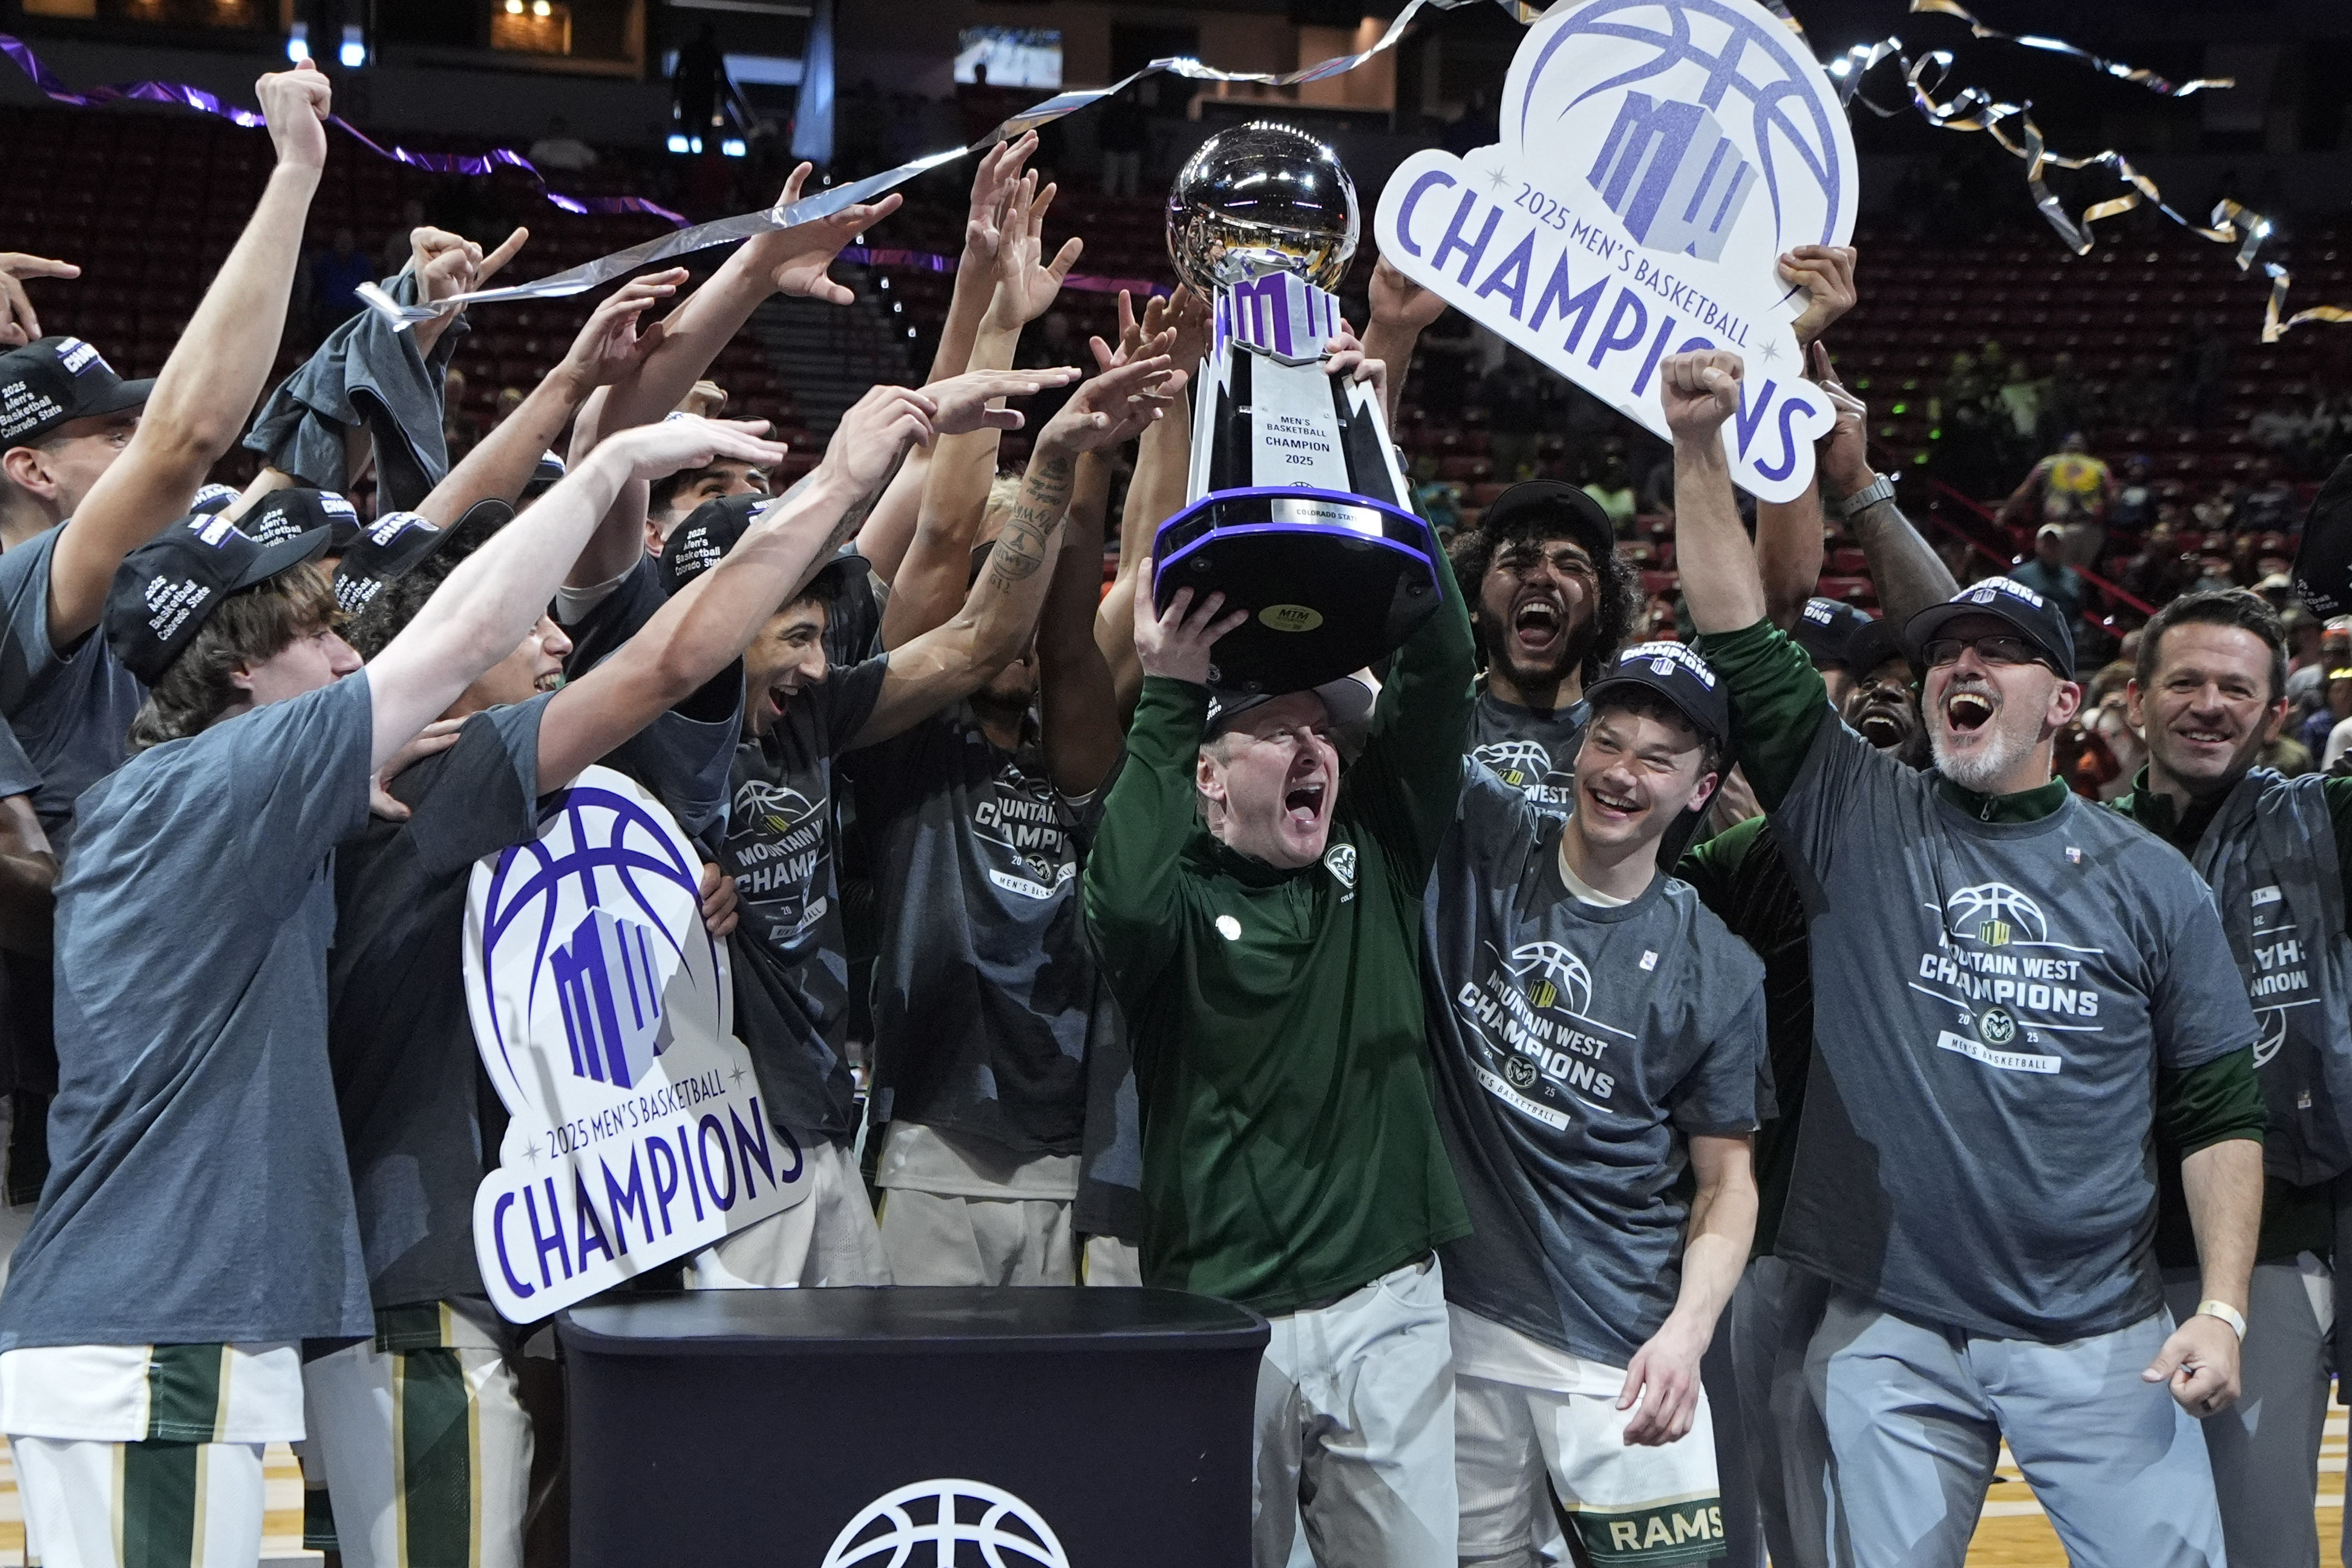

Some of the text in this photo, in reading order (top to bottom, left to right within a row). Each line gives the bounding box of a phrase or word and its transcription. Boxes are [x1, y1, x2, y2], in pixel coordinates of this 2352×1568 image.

[1513, 183, 1749, 348] 2025 MEN'S BASKETBALL
[1397, 170, 1816, 482] CHAMPINS
[1, 381, 27, 399] 2025
[5, 392, 35, 411] Men's
[0, 395, 53, 426] Basketball
[1, 405, 63, 439] Colorado State
[1281, 416, 1311, 426] MEN'S
[1267, 423, 1326, 437] BASKETBALL
[1266, 436, 1330, 452] CHAMPION
[1286, 454, 1313, 466] 2025
[1297, 509, 1336, 518] COLORADO
[683, 538, 709, 551] Men's
[687, 528, 707, 540] 2025
[675, 546, 721, 564] Basketball
[675, 561, 701, 576] Colorado
[148, 584, 179, 612] Men's
[361, 581, 382, 602] State
[148, 579, 198, 630] Basketball
[157, 586, 211, 641] Colorado State
[1279, 609, 1309, 621] MTM
[1620, 645, 1715, 687] CHAMPIONS
[1522, 785, 1569, 804] WEST
[997, 797, 1059, 825] UNTAI
[736, 826, 816, 866] MOUNTAIN
[735, 849, 817, 893] CHAMP
[1011, 855, 1022, 866] 20
[1000, 877, 1027, 892] MEN'S
[781, 906, 792, 915] 20
[2022, 958, 2080, 981] WEST
[1919, 953, 2098, 1016] CHAMPIONS
[1487, 970, 1608, 1060] MOUNTAIN WEST
[1458, 982, 1615, 1099] CHAMPIONS
[1958, 1013, 2039, 1043] 20 25
[1951, 1038, 2047, 1070] MEN'S BASKETBALL
[1497, 1085, 1554, 1122] BASKETBALL
[1545, 1086, 1556, 1097] 25
[546, 1069, 726, 1159] 2025 MEN'S BASKETBALL
[1609, 1507, 1724, 1550] RAMS
